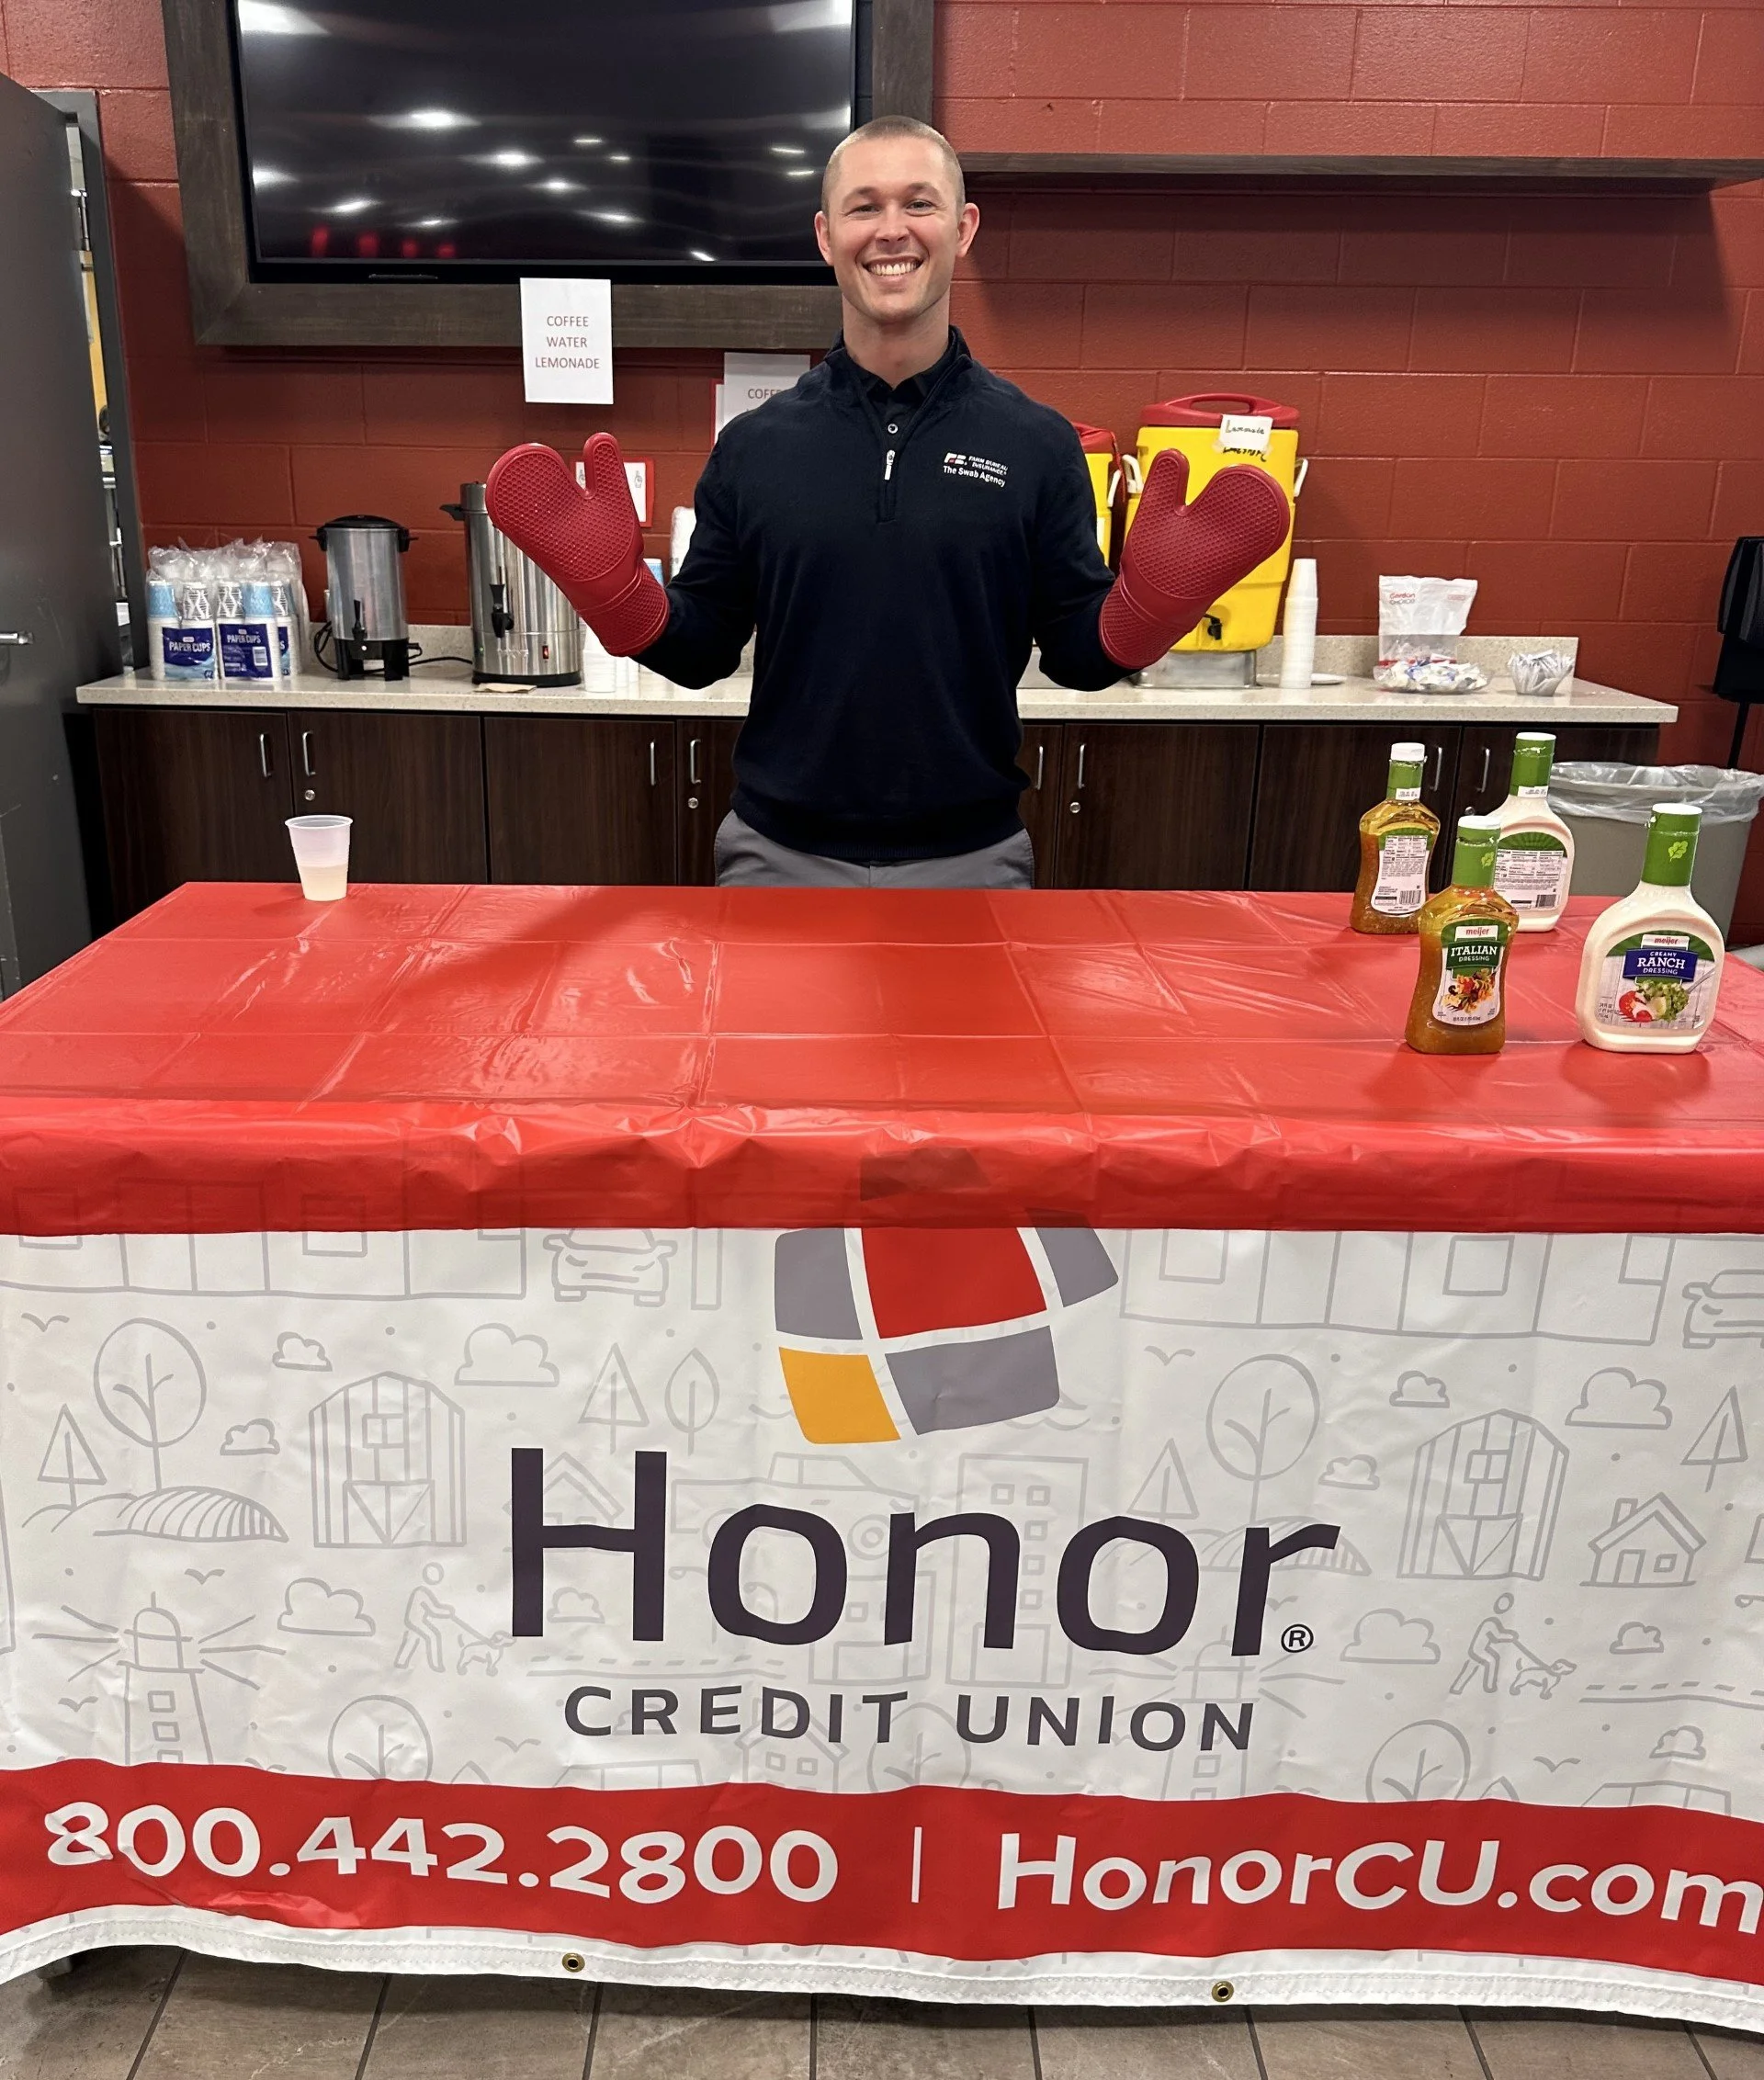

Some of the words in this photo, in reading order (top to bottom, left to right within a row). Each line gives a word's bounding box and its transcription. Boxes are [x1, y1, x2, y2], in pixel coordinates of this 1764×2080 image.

[547, 315, 589, 327] COFFEE
[546, 336, 588, 348] WATER
[535, 356, 600, 369] LEMONADE
[747, 388, 783, 400] COFF
[943, 465, 957, 475] The
[958, 467, 978, 478] Swab
[980, 471, 1005, 487] Agency
[226, 634, 246, 644] PAPER
[245, 634, 262, 644] CUPS
[169, 641, 192, 652] PAPER
[192, 642, 211, 653] CUPS
[1465, 927, 1490, 937] meijer
[1654, 936, 1679, 946] meijer
[1450, 945, 1498, 957] ITALIAN
[1636, 956, 1686, 970] RANCH
[1643, 967, 1679, 976] DRESSING
[564, 1686, 908, 1744] CREDIT
[956, 1694, 1254, 1752] UNION
[44, 1802, 839, 1905] 800.442.2800
[998, 1832, 1764, 1935] HonorCU.com
